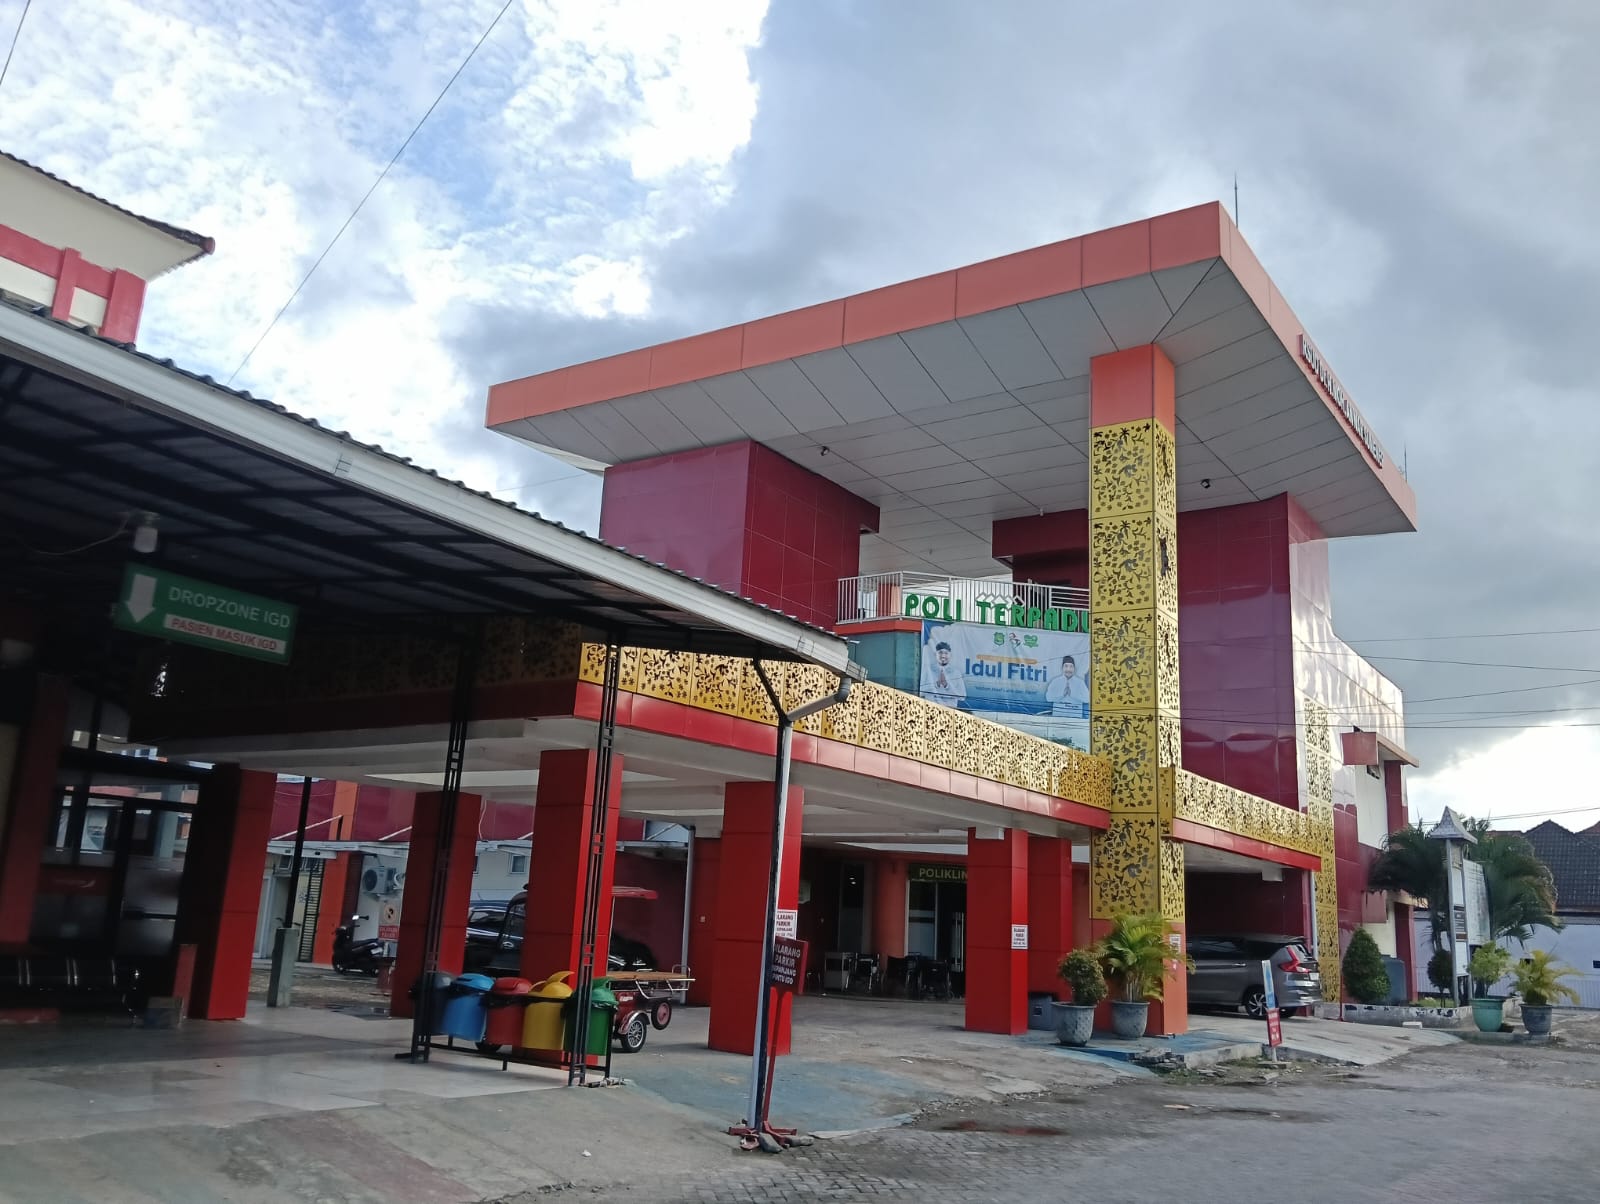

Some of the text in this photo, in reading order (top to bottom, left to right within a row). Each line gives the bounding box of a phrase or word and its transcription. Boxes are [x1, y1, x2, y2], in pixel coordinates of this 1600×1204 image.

[169, 587, 290, 628] DROPZONE IGD
[905, 593, 962, 622] POLI
[171, 617, 277, 650] PASIEN MASUK IGD
[965, 658, 1048, 682] Idul Fitri
